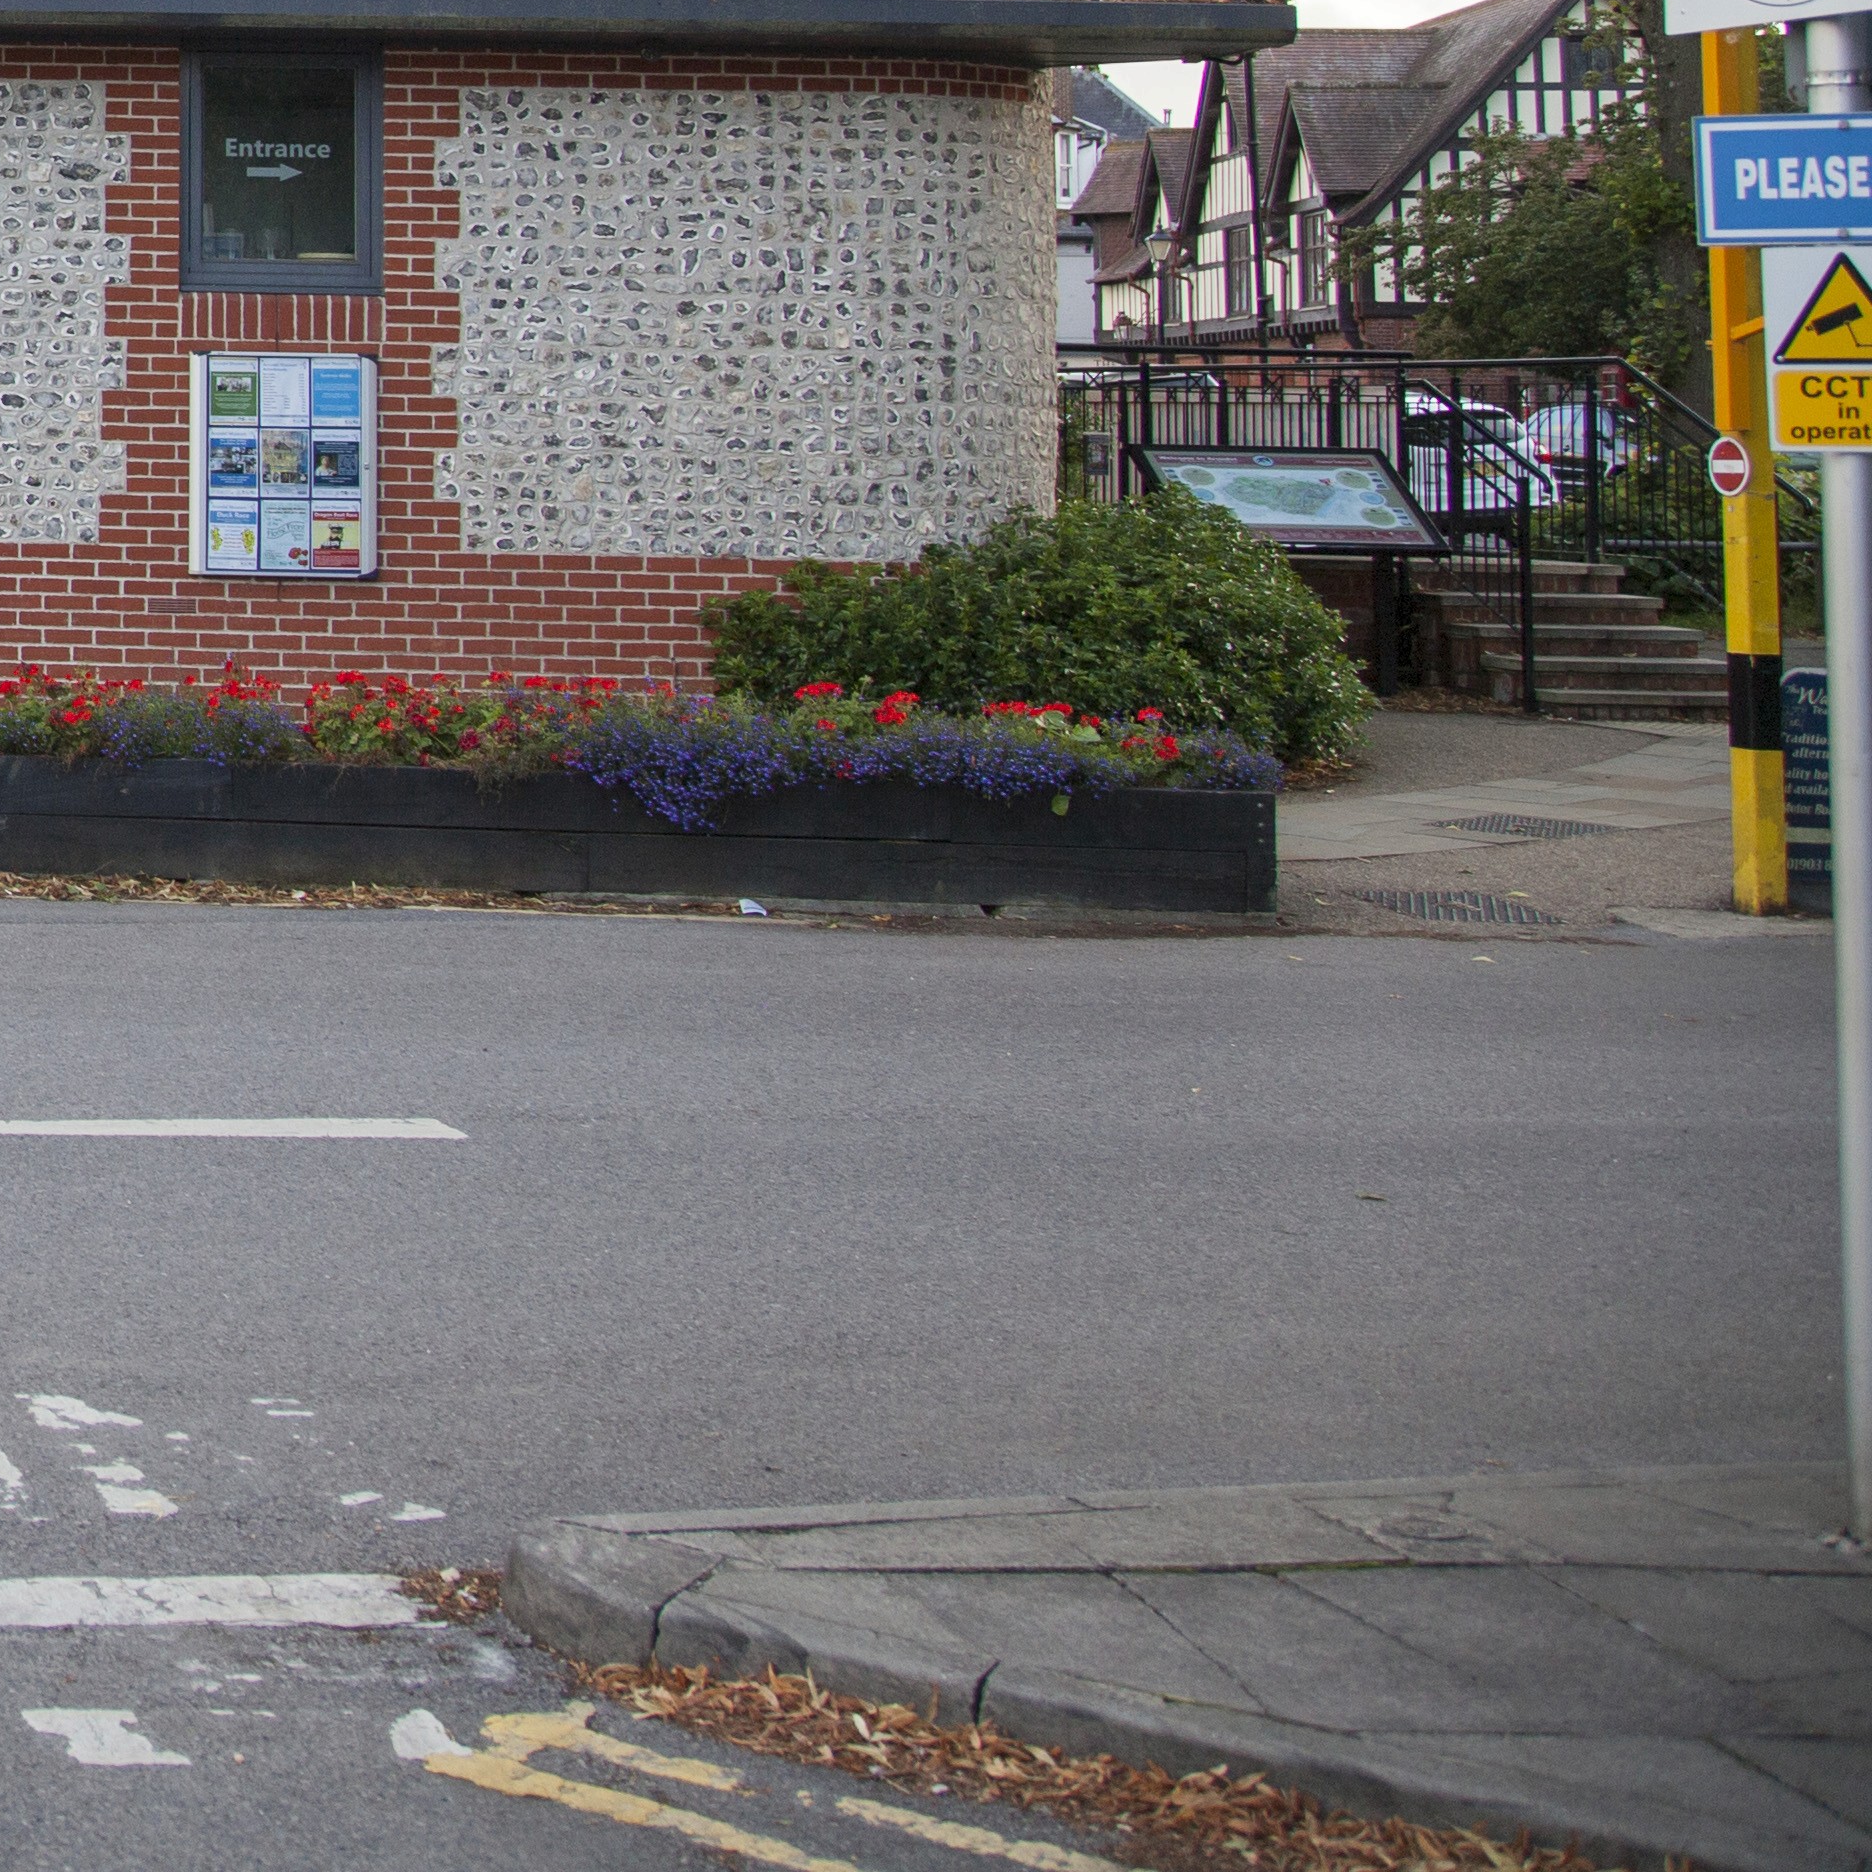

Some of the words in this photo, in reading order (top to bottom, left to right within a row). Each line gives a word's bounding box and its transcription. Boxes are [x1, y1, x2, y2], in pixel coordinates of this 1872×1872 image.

[225, 137, 331, 158] Entrance
[1734, 155, 1871, 200] PLEASE
[1838, 402, 1860, 419] in
